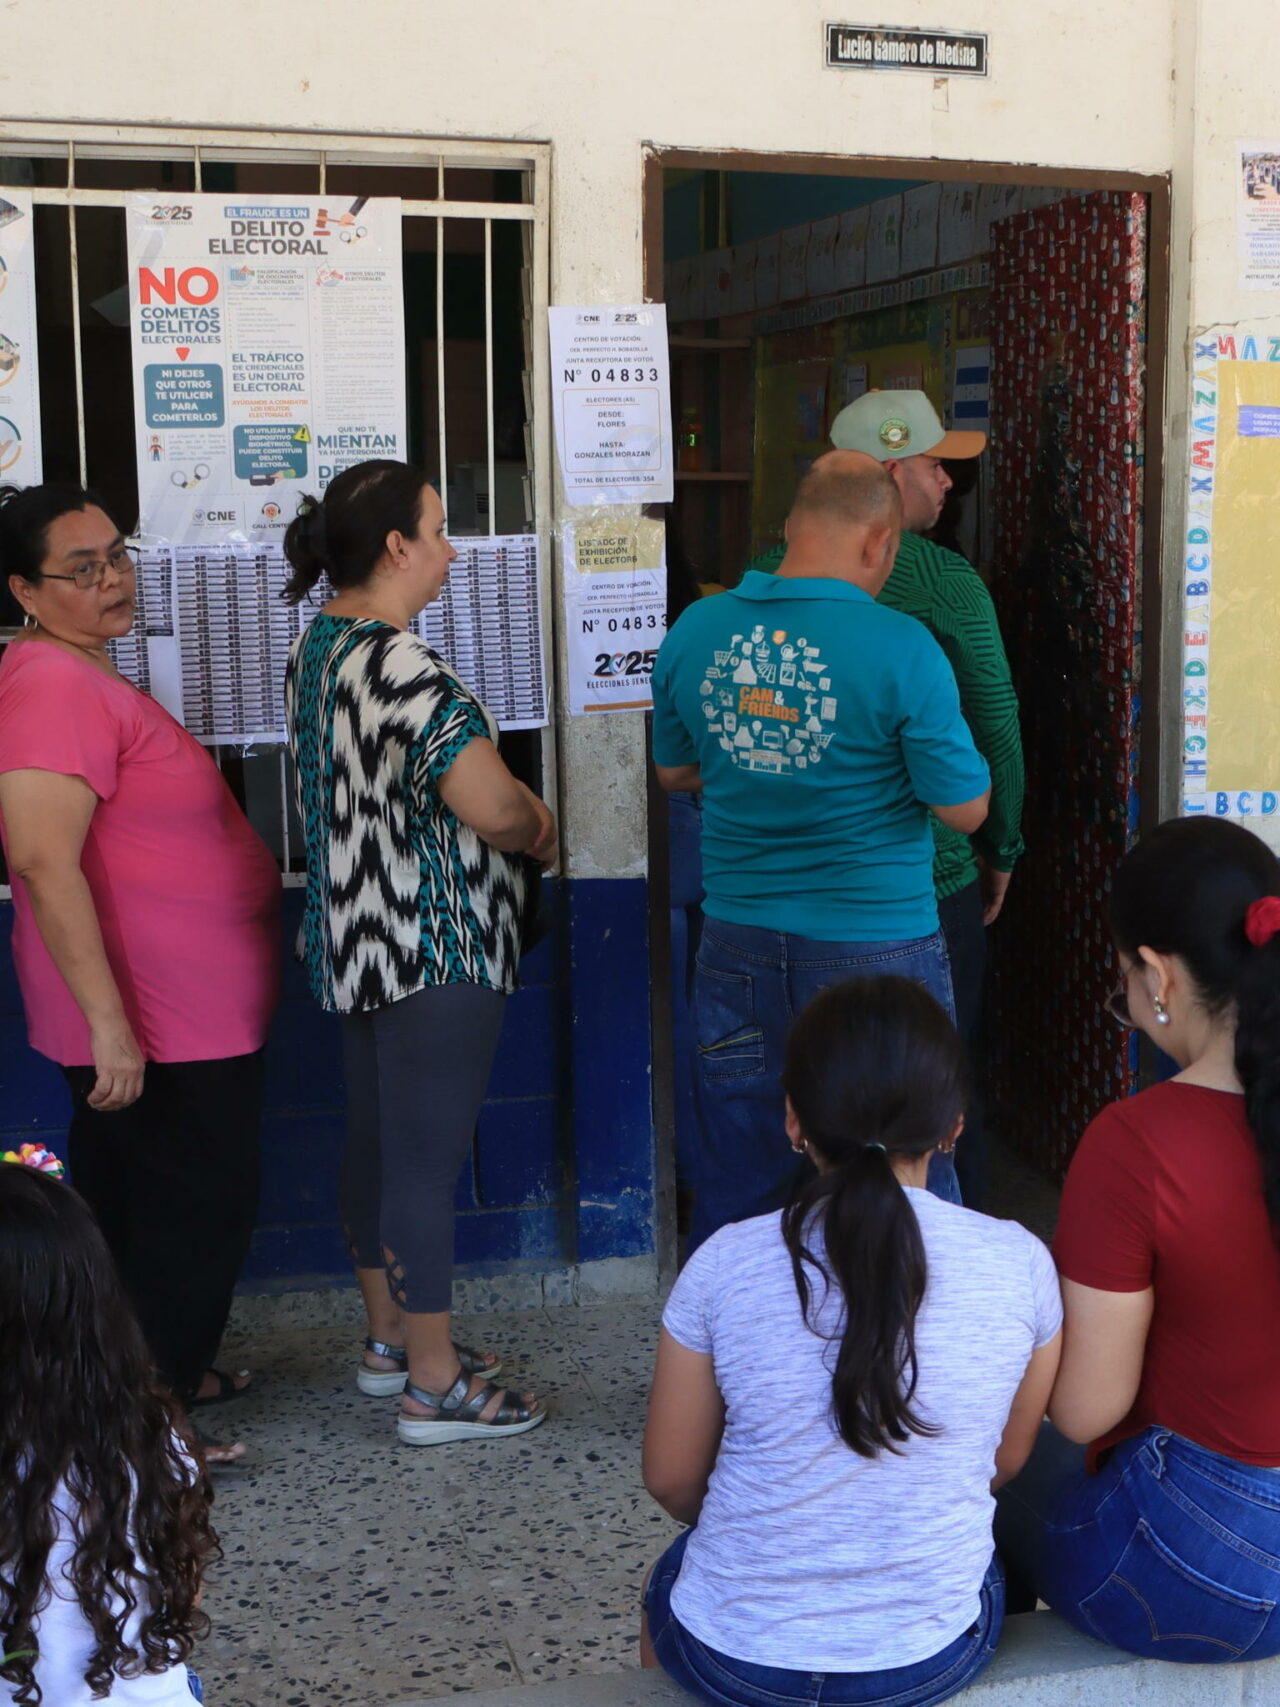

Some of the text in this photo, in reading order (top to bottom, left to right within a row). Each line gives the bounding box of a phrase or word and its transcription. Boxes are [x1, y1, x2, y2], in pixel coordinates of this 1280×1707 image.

[874, 39, 918, 64] Gamero
[919, 39, 934, 64] de
[936, 40, 977, 67] Medina
[151, 205, 193, 220] 2025
[226, 208, 307, 218] EL FRAUDE ES UN
[231, 221, 304, 237] DELITO
[208, 239, 328, 255] ELECTORAL
[138, 266, 219, 306] NO
[141, 307, 220, 319] COMETAS
[140, 320, 221, 334] DELITOS
[141, 335, 221, 344] ELECTORALES
[232, 350, 304, 363] EL TRÁFICO
[161, 369, 205, 378] NI DEJES
[233, 373, 305, 381] ES UN DELITO
[591, 368, 659, 382] 04833
[155, 380, 212, 390] QUE OTROS
[233, 382, 305, 392] ELECTORAL
[155, 391, 213, 400] TE UTILICEN
[171, 402, 198, 411] PARA
[152, 413, 218, 422] COMETERLOS
[317, 434, 397, 449] MIENTAN
[574, 450, 651, 459] GONZALES MORAZAN
[207, 511, 236, 521] CNE
[579, 547, 628, 556] EXHIBICIÓN
[580, 557, 592, 566] DE
[592, 583, 616, 591] CENTRO
[644, 603, 665, 611] VOTOS
[587, 678, 630, 689] ELECCIONES
[739, 685, 785, 706] CAM &
[738, 700, 800, 723] FRIENDS
